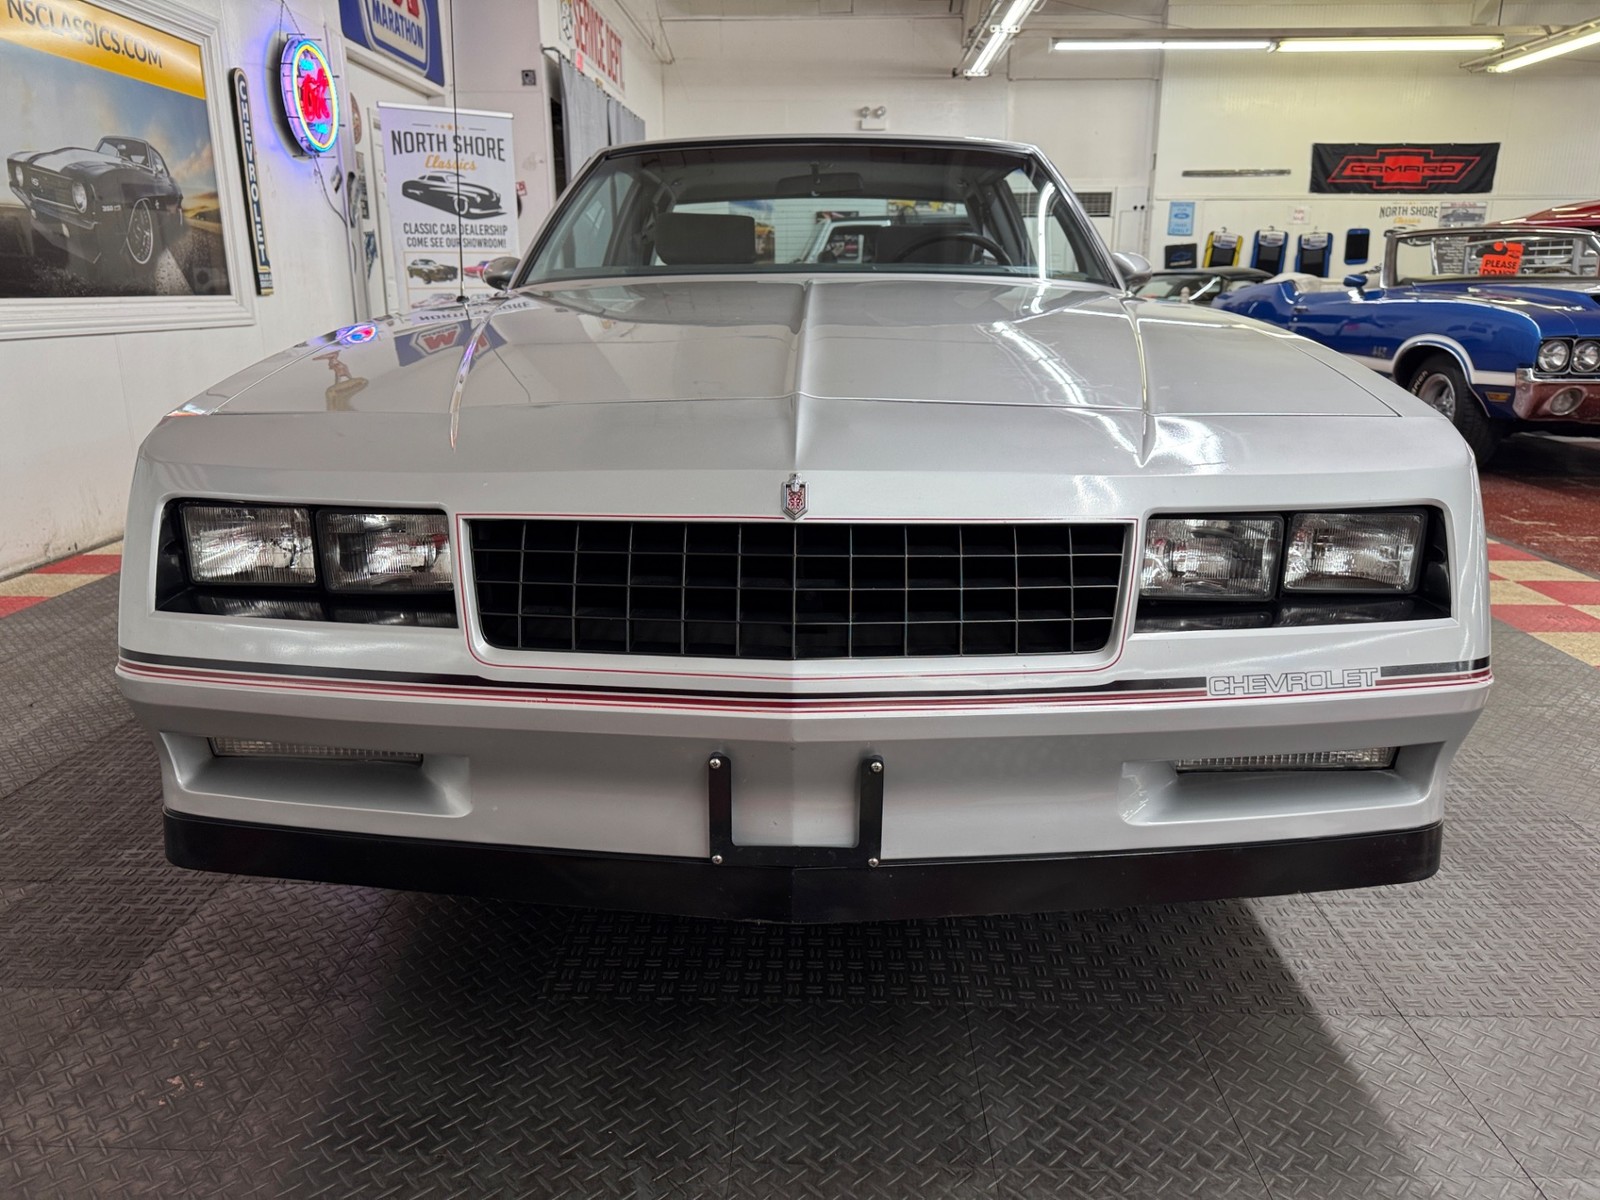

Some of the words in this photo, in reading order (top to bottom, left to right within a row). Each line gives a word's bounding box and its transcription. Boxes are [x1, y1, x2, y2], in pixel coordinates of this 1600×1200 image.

[7, 0, 163, 68] NSCLASSICS.COM
[372, 0, 424, 50] MARATHON
[573, 0, 605, 74] SERVICE
[391, 130, 447, 155] NORTH
[453, 134, 506, 162] SHORE
[239, 85, 266, 263] CHEVROLET
[424, 154, 477, 171] Classics
[1350, 164, 1455, 173] CAMARO
[1379, 206, 1408, 218] NORTH
[1410, 206, 1438, 218] SHORE
[403, 223, 438, 235] CLASSIC
[440, 224, 457, 235] CAR
[460, 224, 508, 236] DEALERSHIP
[406, 237, 429, 247] COME
[430, 237, 444, 247] SEE
[445, 238, 460, 248] OUR
[463, 238, 507, 248] SHOWROOM!
[1485, 259, 1517, 270] PLEASE
[1208, 667, 1378, 696] CHEVROLET
